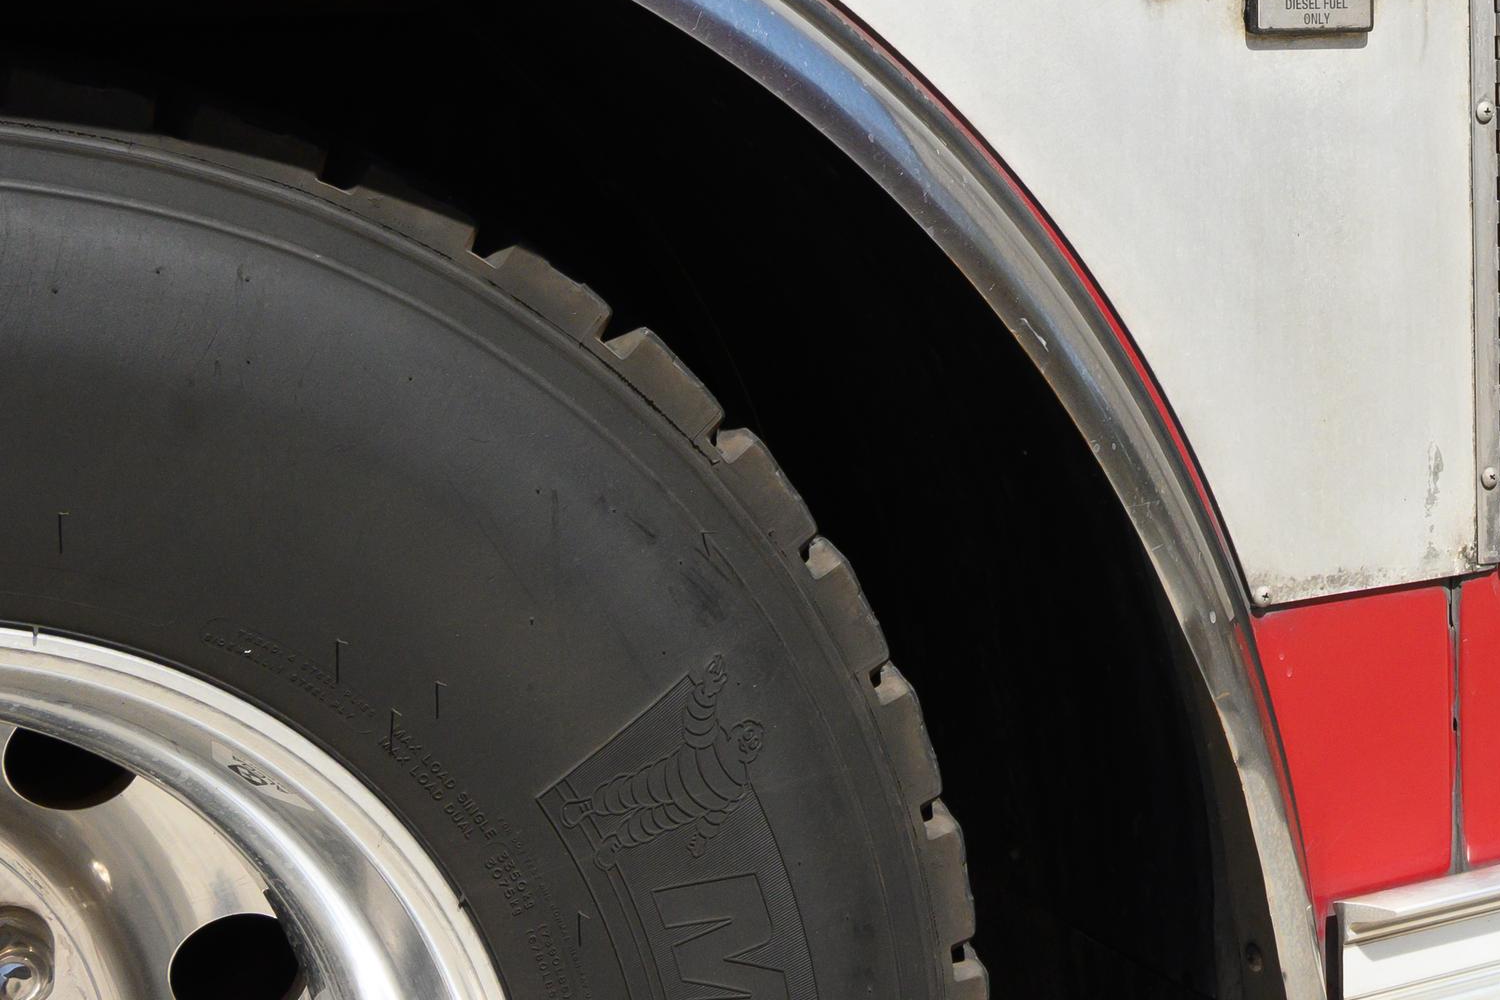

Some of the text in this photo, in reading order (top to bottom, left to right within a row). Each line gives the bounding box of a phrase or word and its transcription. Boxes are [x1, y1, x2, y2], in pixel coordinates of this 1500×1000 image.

[1303, 12, 1330, 25] ONLY
[391, 724, 422, 754] MAX
[421, 752, 456, 790] LOAD
[457, 791, 497, 840] SINGLE
[409, 764, 444, 801] LOAD
[443, 801, 476, 839] DUAL
